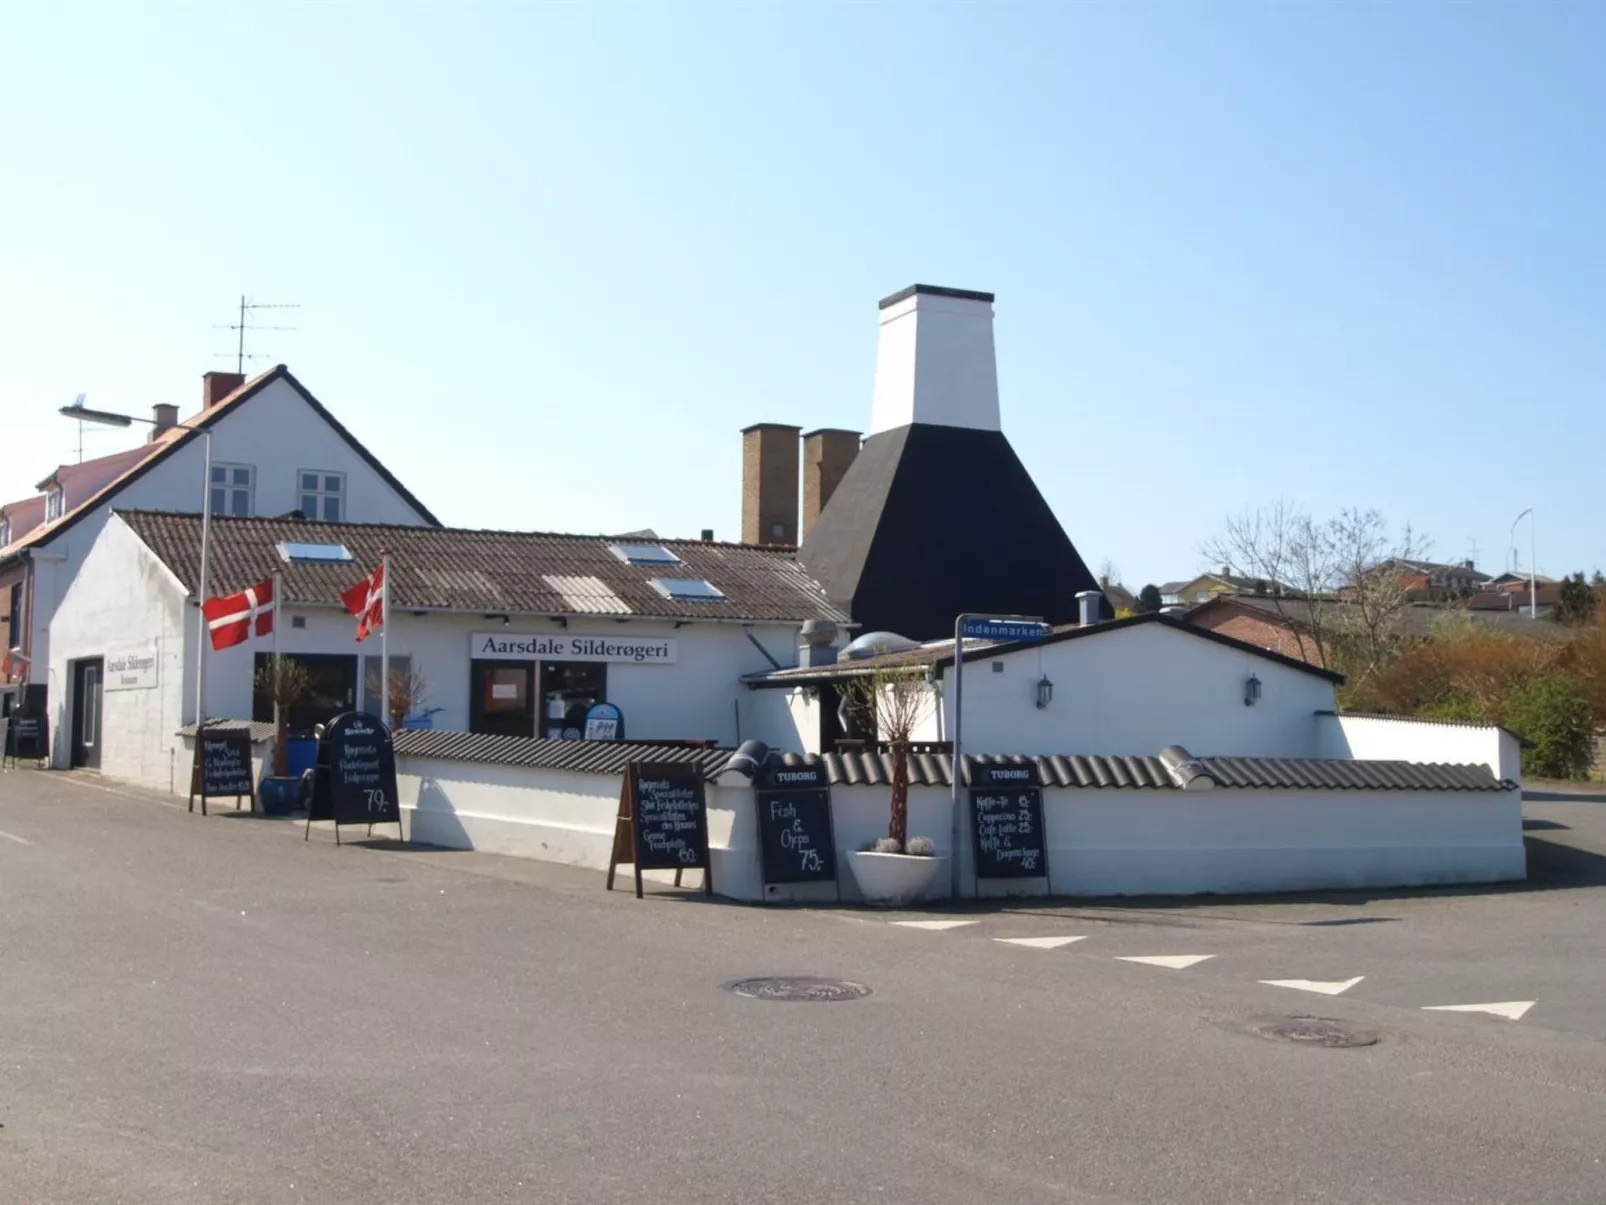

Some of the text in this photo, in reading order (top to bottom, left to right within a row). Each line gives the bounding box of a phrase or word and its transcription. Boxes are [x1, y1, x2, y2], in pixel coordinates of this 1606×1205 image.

[963, 624, 1043, 637] Indenmarken
[482, 637, 669, 661] Aarsdale Silderøgeri
[777, 771, 817, 782] TUBORG
[991, 770, 1030, 780] TUBORG
[770, 800, 797, 820] Fish
